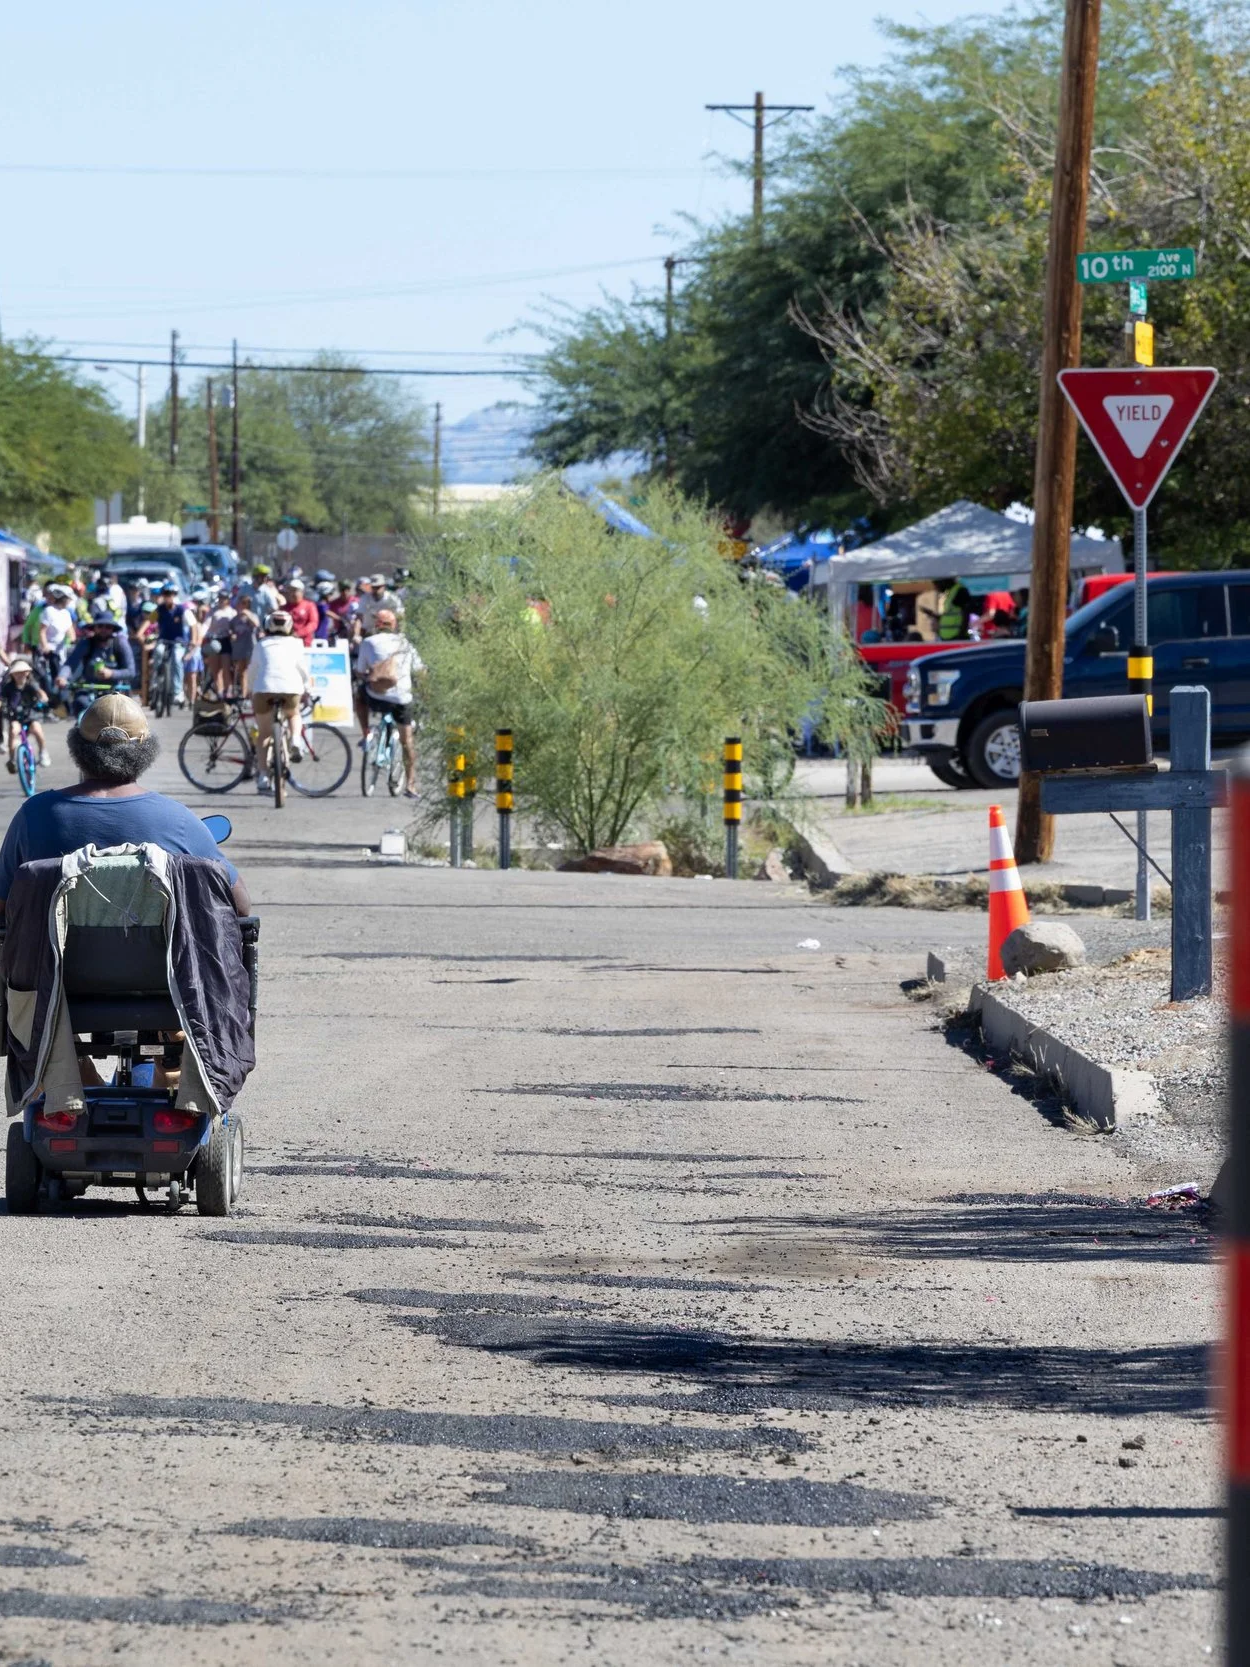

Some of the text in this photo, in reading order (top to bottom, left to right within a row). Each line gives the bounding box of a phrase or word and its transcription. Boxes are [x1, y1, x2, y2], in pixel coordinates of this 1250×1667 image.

[1157, 252, 1180, 263] Ave
[1081, 255, 1134, 279] 10th
[1147, 264, 1191, 277] 2100 N
[1116, 404, 1161, 421] YIELD
